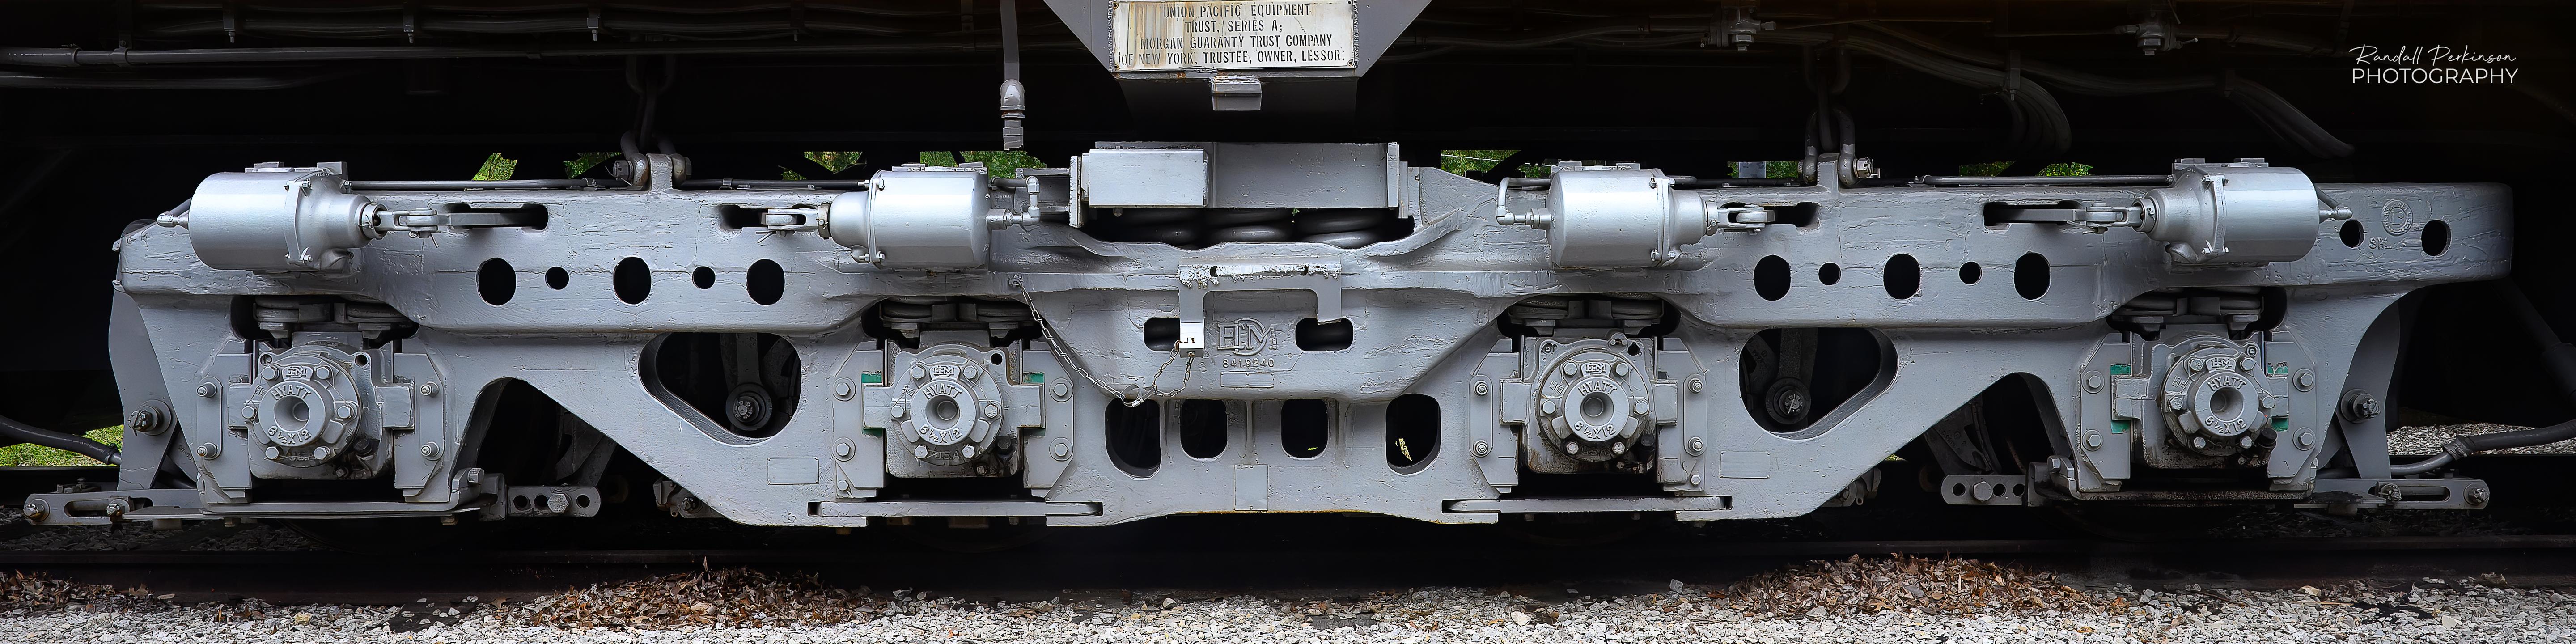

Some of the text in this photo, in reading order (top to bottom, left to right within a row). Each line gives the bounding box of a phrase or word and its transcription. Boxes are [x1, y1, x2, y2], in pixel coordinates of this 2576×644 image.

[1164, 4, 1310, 18] UNION PACIFIC EQUIPMENT
[1185, 19, 1282, 34] TRUST, SERIES A;
[1141, 34, 1332, 50] MORGAN GUARANTY TRUST COMPANY
[1122, 49, 1345, 65] OF NEW YORK, TRUSTEE, OWNER, LESSOR.
[1222, 357, 1275, 368] 8419240
[1578, 381, 1618, 396] HYATT
[2207, 375, 2247, 391] HYATT
[271, 384, 312, 401] HYATT
[922, 383, 963, 400] HYATT
